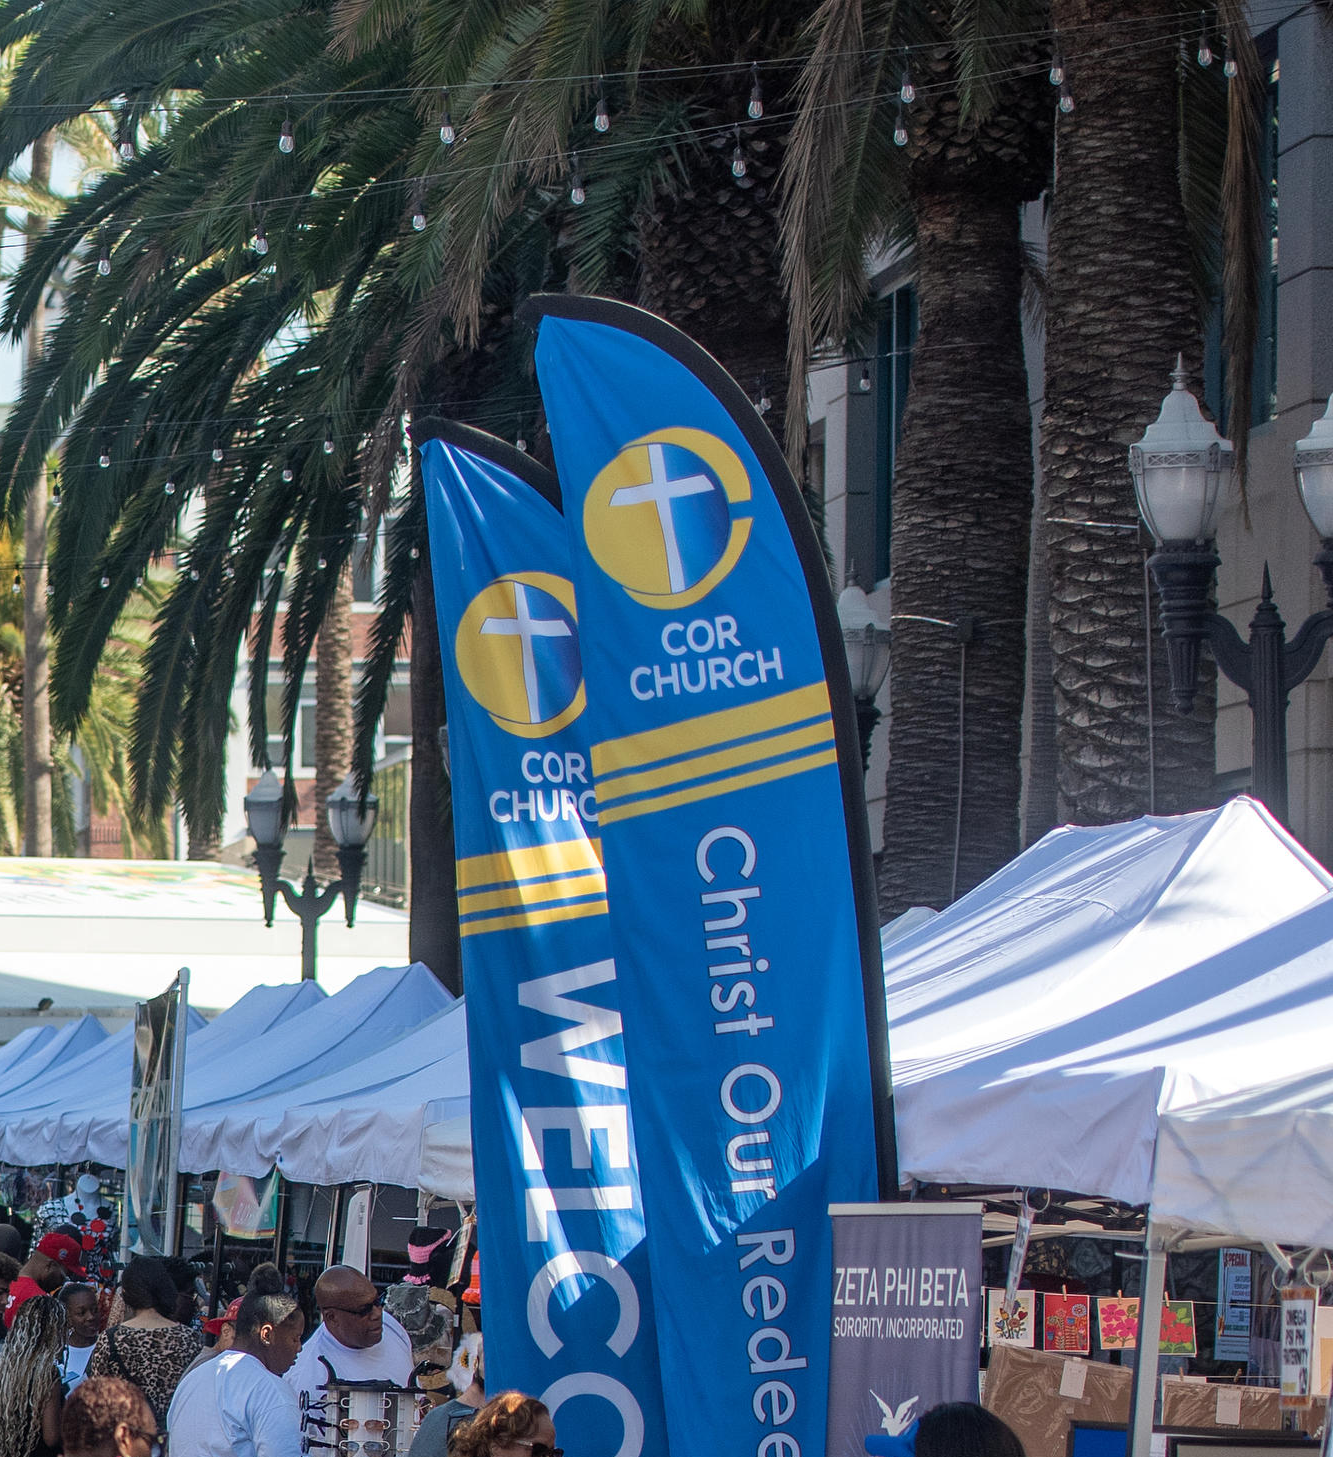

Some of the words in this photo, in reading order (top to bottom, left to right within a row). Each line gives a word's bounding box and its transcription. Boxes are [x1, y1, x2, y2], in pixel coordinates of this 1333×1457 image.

[661, 614, 742, 657] COR
[630, 648, 784, 702] CHURCH
[521, 751, 588, 785] COR
[696, 825, 775, 1036] Christ
[719, 1062, 782, 1201] Our
[833, 1267, 879, 1306] ZETA
[883, 1267, 916, 1306] PHI
[919, 1267, 969, 1308] BETA
[833, 1316, 884, 1339] SORORITY,
[885, 1317, 964, 1340] INCORPORATED
